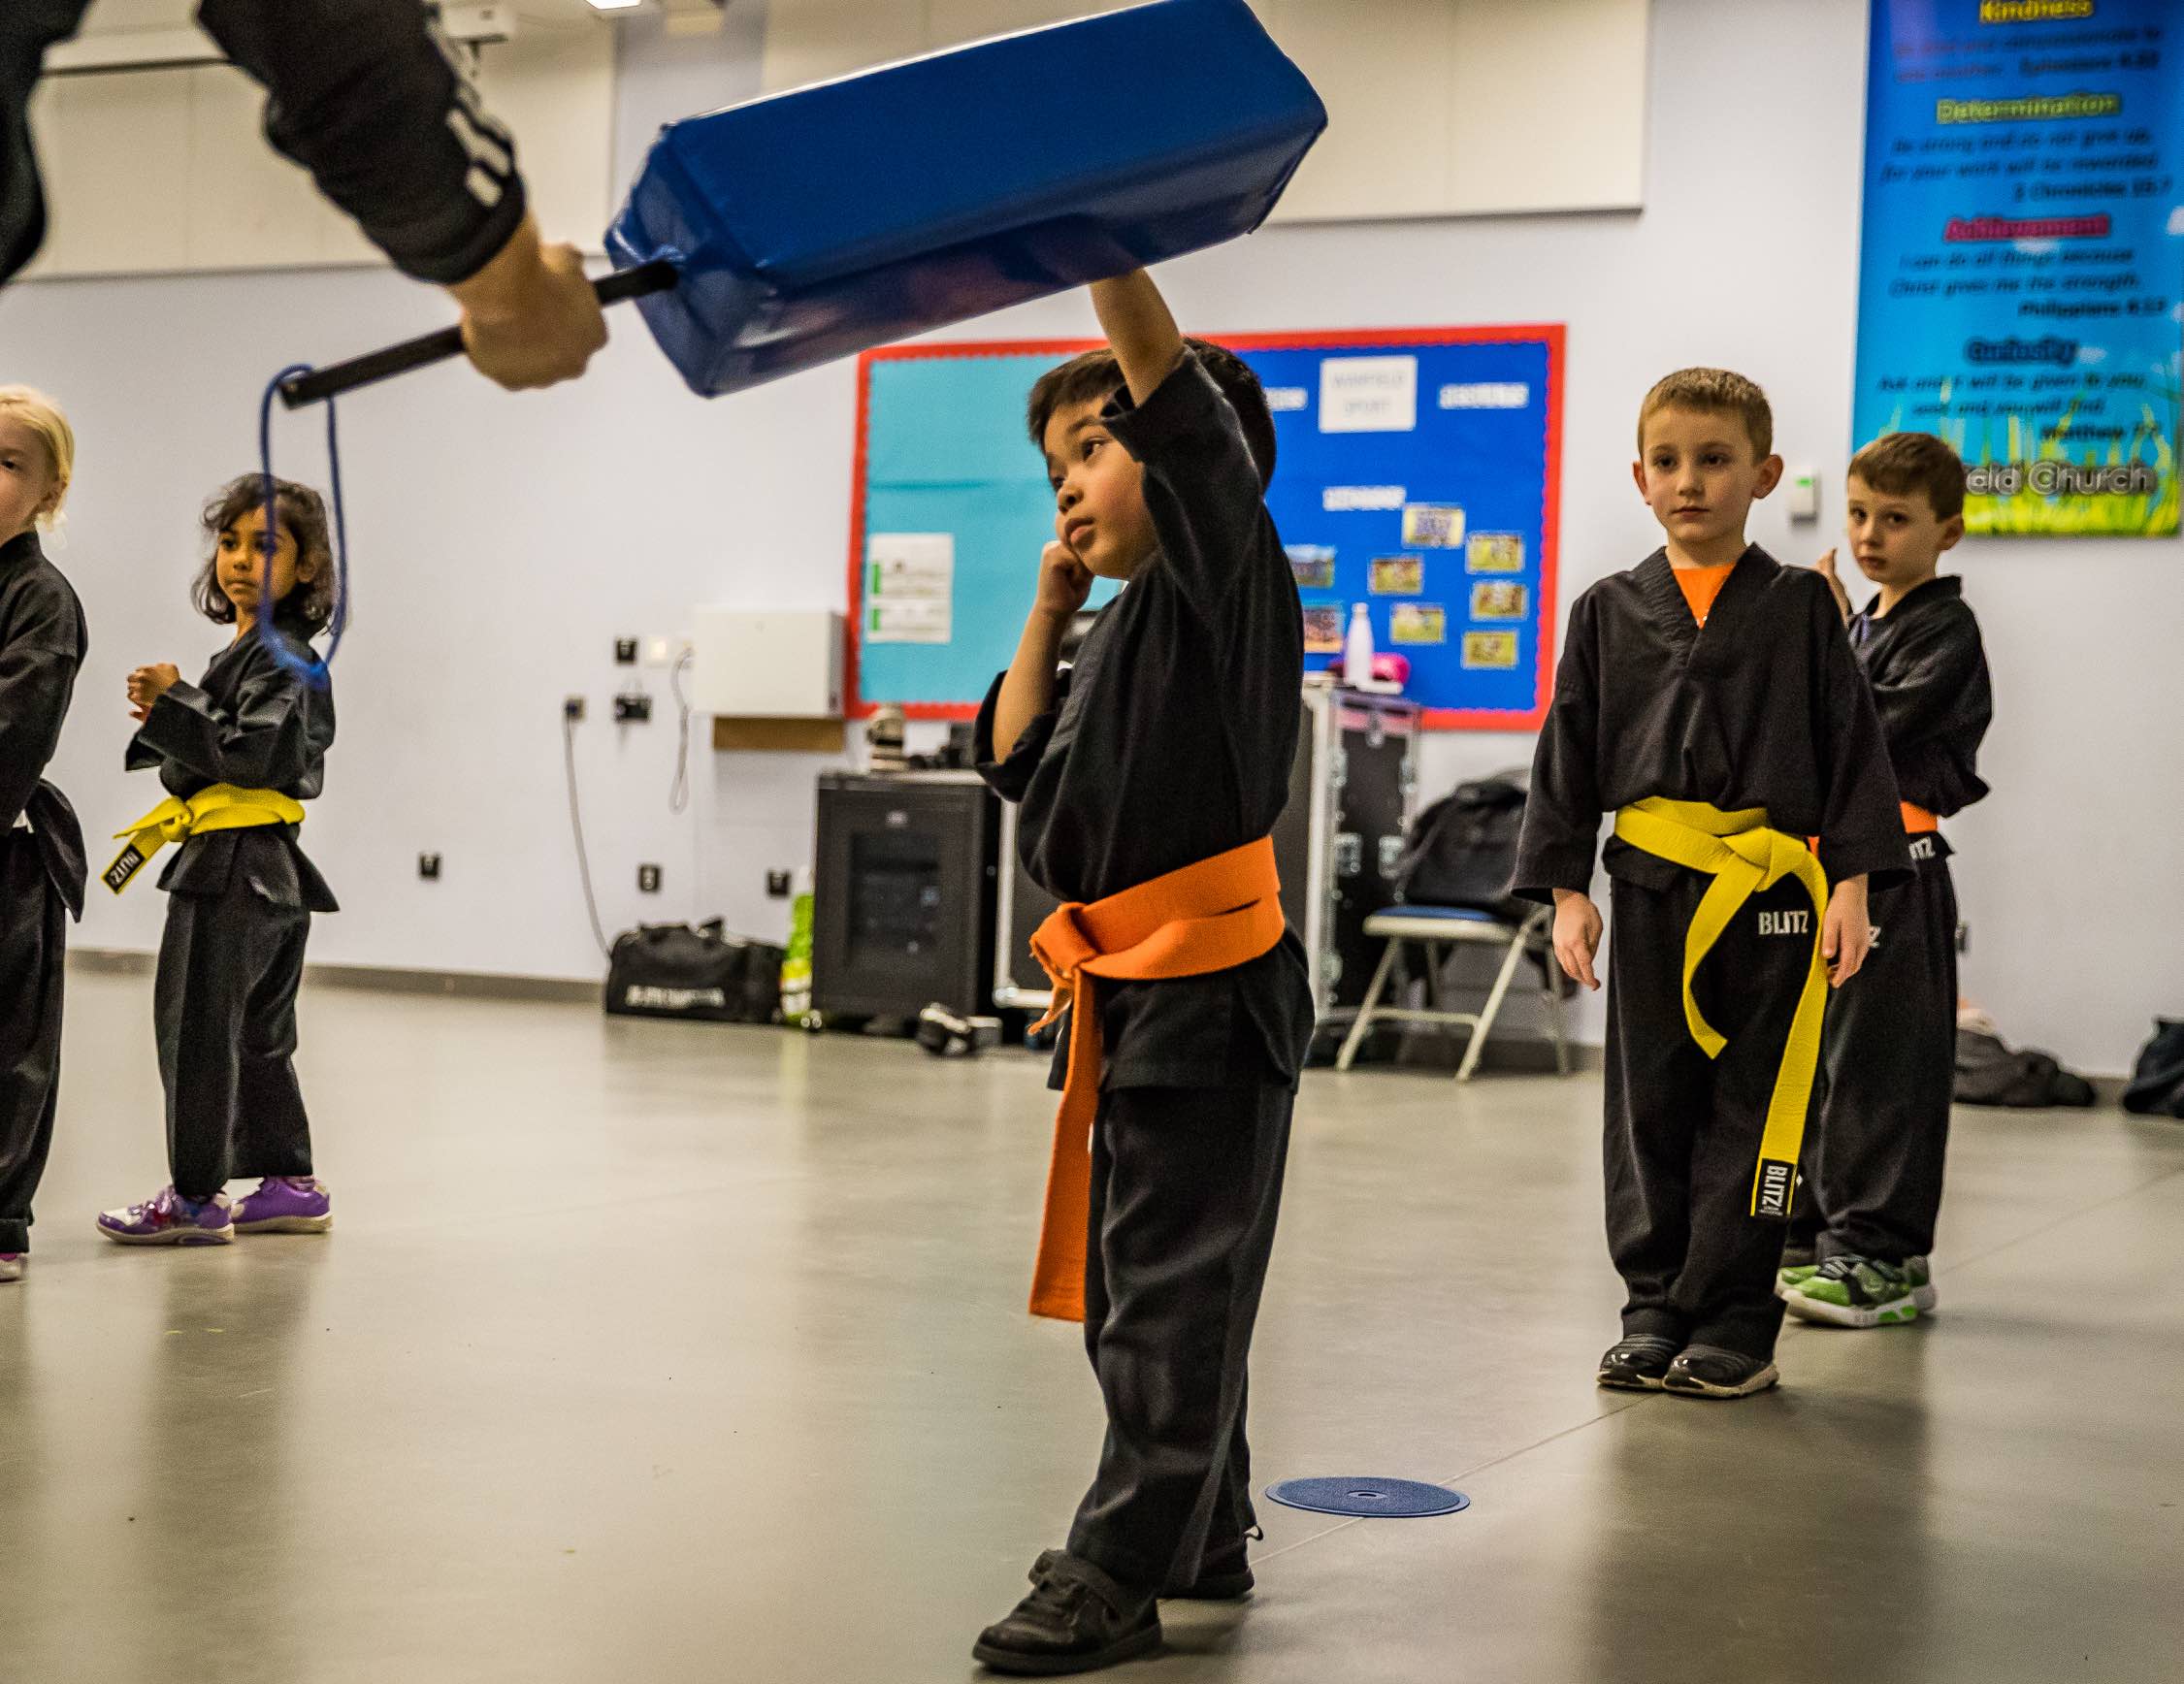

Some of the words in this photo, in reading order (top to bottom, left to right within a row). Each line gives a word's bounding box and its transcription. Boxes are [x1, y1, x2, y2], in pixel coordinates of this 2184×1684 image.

[1979, 0, 2095, 22] Kindness
[1936, 94, 2122, 124] Determination
[1943, 212, 2112, 243] Achievement
[2028, 460, 2159, 496] Church
[1908, 836, 1936, 860] ITZ
[109, 850, 141, 887] BLITZ
[1758, 910, 1809, 936] BLITZ
[1761, 1165, 1789, 1209] BLITZ
